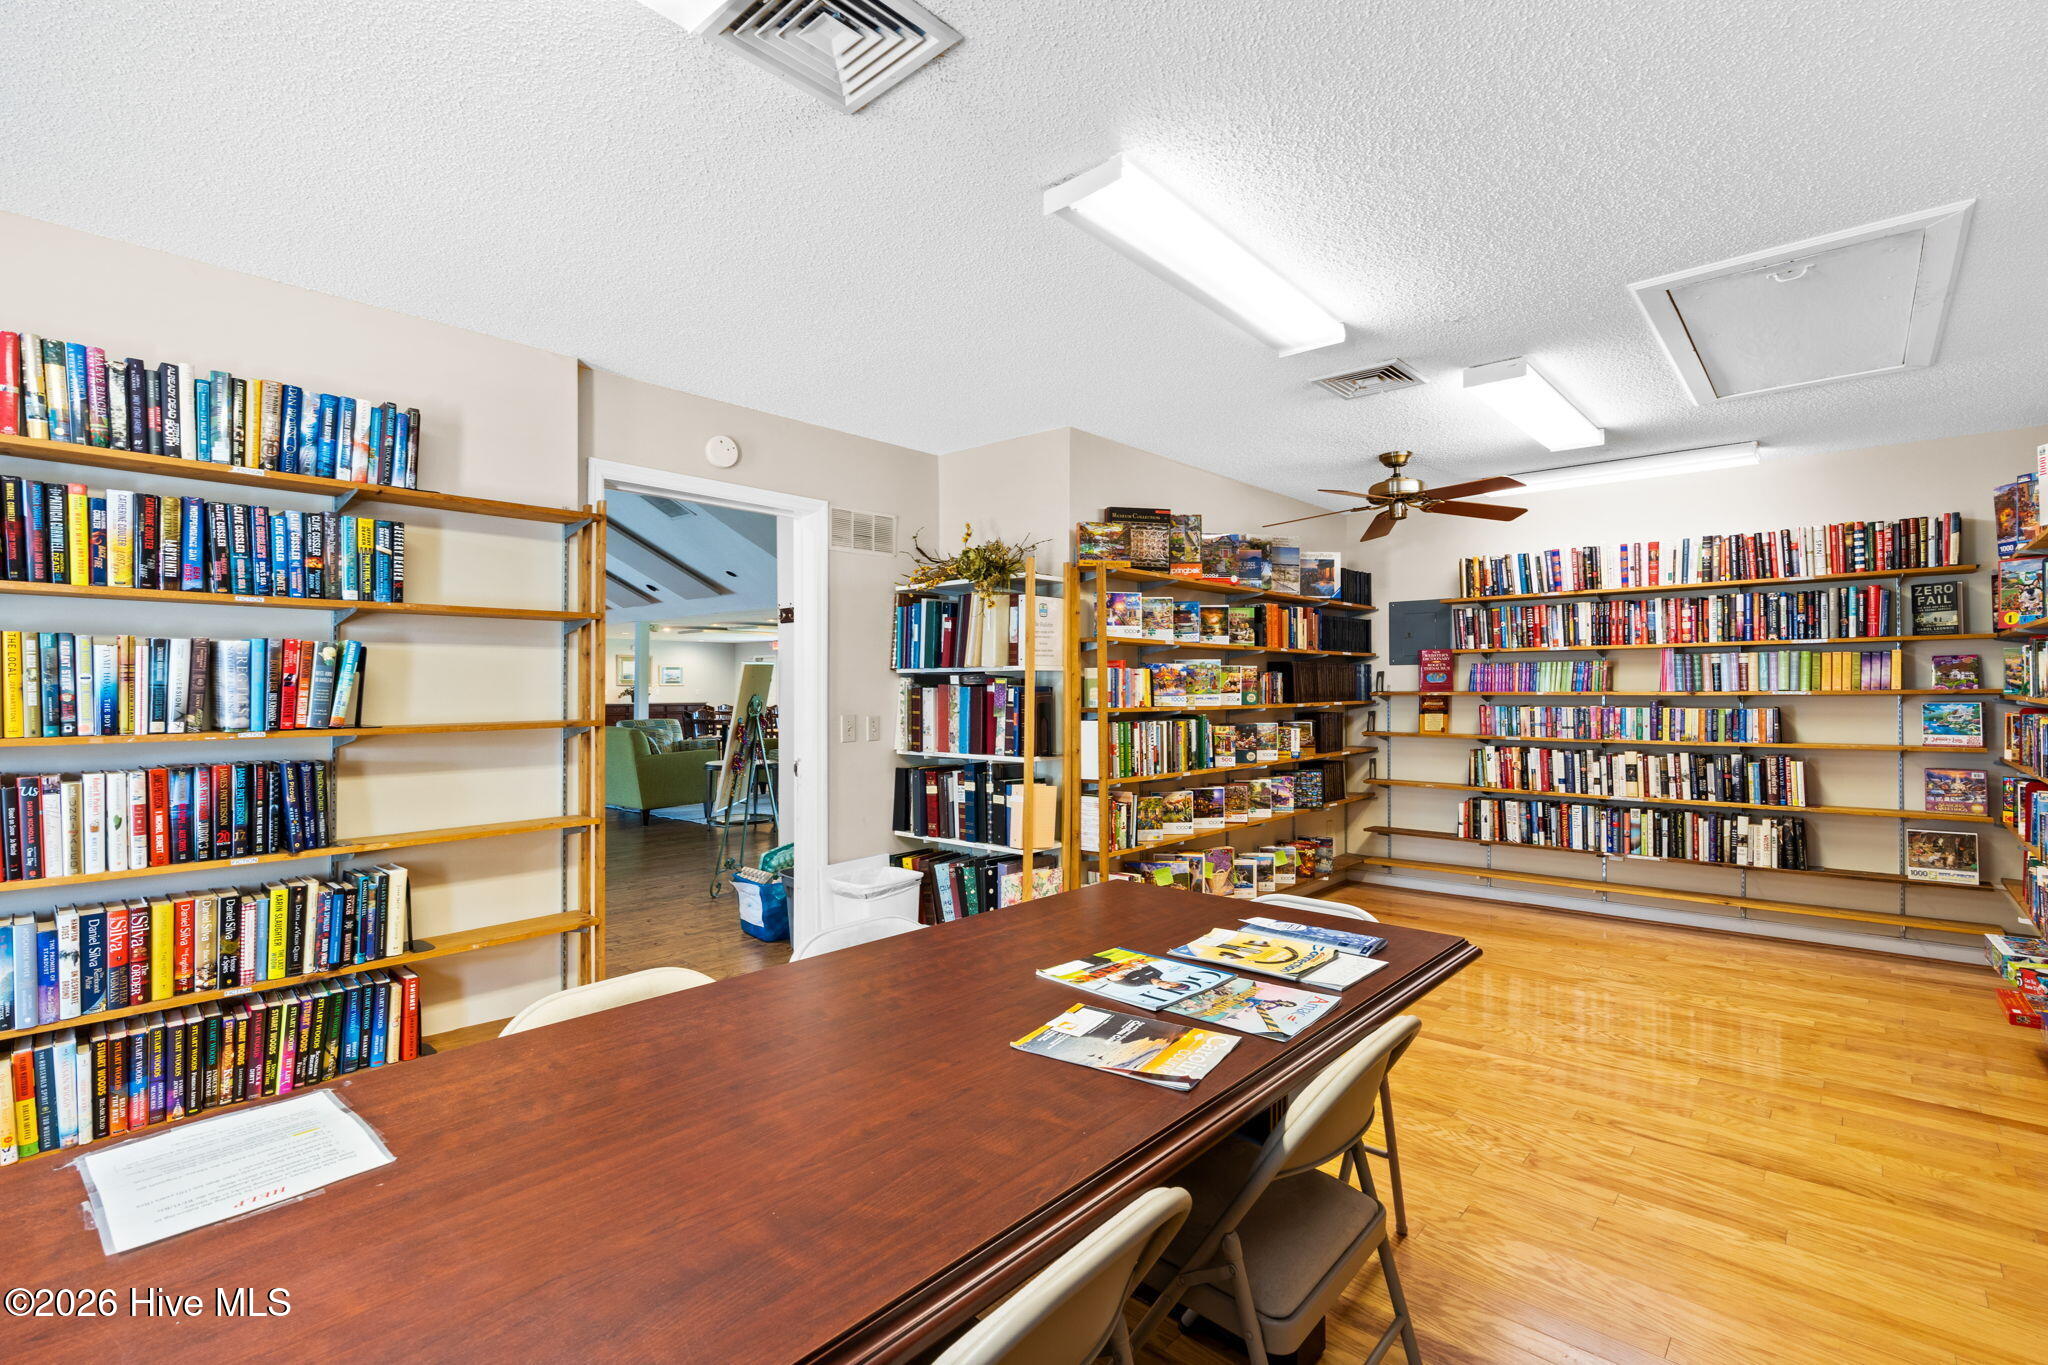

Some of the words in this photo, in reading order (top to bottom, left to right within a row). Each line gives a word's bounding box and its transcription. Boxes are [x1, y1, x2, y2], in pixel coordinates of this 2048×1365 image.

[95, 353, 106, 383] MAEVE
[168, 366, 176, 396] ALREADY
[96, 386, 107, 418] BINCHY
[288, 386, 298, 406] DAN
[168, 398, 177, 418] DEAD
[325, 408, 333, 425] SANDRA
[165, 419, 175, 446] BOOTH
[286, 408, 297, 438] BROWN
[324, 426, 333, 443] BROWN
[286, 445, 296, 473] ORIGIN
[6, 502, 16, 522] CONNELLY
[49, 496, 62, 521] PATRICIA
[118, 494, 127, 522] CATHERINE
[145, 497, 156, 525] CATHERINE
[215, 504, 224, 520] CLIVE
[233, 506, 243, 524] CLIVE
[255, 508, 264, 525] CLIVE
[93, 510, 101, 529] COULTER
[189, 505, 199, 547] INDEPENDENCE
[275, 518, 284, 534] CLIVE
[290, 513, 300, 530] CLIVE
[312, 515, 320, 530] CLIVE
[50, 522, 64, 551] CORNWELL
[118, 524, 126, 547] COULTER
[145, 527, 154, 549] COULTER
[216, 521, 226, 547] CUSSLER
[235, 525, 245, 553] CUSSLER
[255, 526, 266, 558] CUSSLER'S
[312, 532, 321, 556] CUSSLER
[394, 526, 404, 554] JEFFERY
[189, 549, 198, 561] DAY
[276, 536, 285, 561] CUSSLER
[291, 532, 300, 560] CUSSLER
[52, 553, 60, 573] DEATH
[164, 539, 178, 577] LABYRINTH
[394, 555, 404, 580] DEAVER
[277, 569, 285, 591] PIRATE
[1169, 566, 1201, 576] pringbok
[1914, 584, 1954, 596] ZERO
[1917, 595, 1952, 606] FAIL
[8, 633, 17, 648] THE
[8, 652, 17, 677] LOCAL
[236, 646, 248, 682] GREG
[238, 688, 248, 713] ILES
[219, 768, 228, 788] JAMES
[236, 768, 246, 787] JAMES
[288, 781, 296, 802] Picoult
[27, 801, 35, 817] DAVID
[219, 790, 228, 826] PATTERSON
[236, 789, 246, 824] PATTERSON
[28, 818, 36, 844] NICHOLLS
[155, 815, 163, 833] MICHAEL
[155, 835, 164, 853] BENNETT
[216, 832, 231, 843] 20
[234, 832, 247, 842] 17
[231, 857, 259, 865] FICTION
[1910, 869, 1928, 877] 1000
[201, 900, 211, 922] Daniel
[225, 899, 236, 921] Daniel
[275, 894, 283, 912] KARIN
[179, 904, 190, 927] Daniel
[62, 925, 70, 940] SIDES
[71, 919, 79, 941] HAMPTON
[88, 919, 100, 945] Daniel
[110, 918, 128, 952] Silva
[131, 915, 150, 948] Silva
[179, 927, 191, 946] Silva
[200, 923, 211, 941] Silva
[225, 922, 236, 940] Silva
[274, 913, 283, 946] SLAUGHTER
[293, 929, 301, 945] VIRGIN
[88, 947, 101, 967] Silva
[179, 954, 188, 974] English
[292, 945, 300, 961] QUEEN
[131, 964, 142, 996] ORDER
[141, 963, 150, 976] The
[110, 971, 120, 1003] WOMAN
[270, 1009, 279, 1031] STUART
[289, 1006, 297, 1028] STUART
[303, 1002, 312, 1025] STUART
[316, 998, 325, 1023] STUART
[209, 1019, 217, 1041] STUART
[238, 1020, 247, 1042] STUART
[254, 1012, 263, 1034] STUART
[154, 1030, 162, 1053] STUART
[175, 1029, 183, 1052] STUART
[191, 1025, 199, 1047] STUART
[253, 1035, 262, 1058] WOODS
[268, 1032, 278, 1055] WOODS
[287, 1029, 296, 1052] WOODS
[301, 1028, 311, 1053] WOODS
[313, 1024, 322, 1049] WOODS
[97, 1042, 107, 1068] STUART
[114, 1041, 122, 1065] STUART
[135, 1036, 143, 1061] STUART
[208, 1042, 216, 1065] WOODS
[237, 1043, 246, 1065] WOODS
[153, 1053, 162, 1078] WOODS
[174, 1053, 182, 1076] WOODS
[190, 1049, 198, 1071] WOODS
[285, 1058, 293, 1069] HIT
[97, 1070, 107, 1096] WOODS
[114, 1066, 122, 1090] WOODS
[135, 1061, 143, 1085] WOODS
[284, 1070, 292, 1084] LIST
[233, 1186, 286, 1209] HELP
